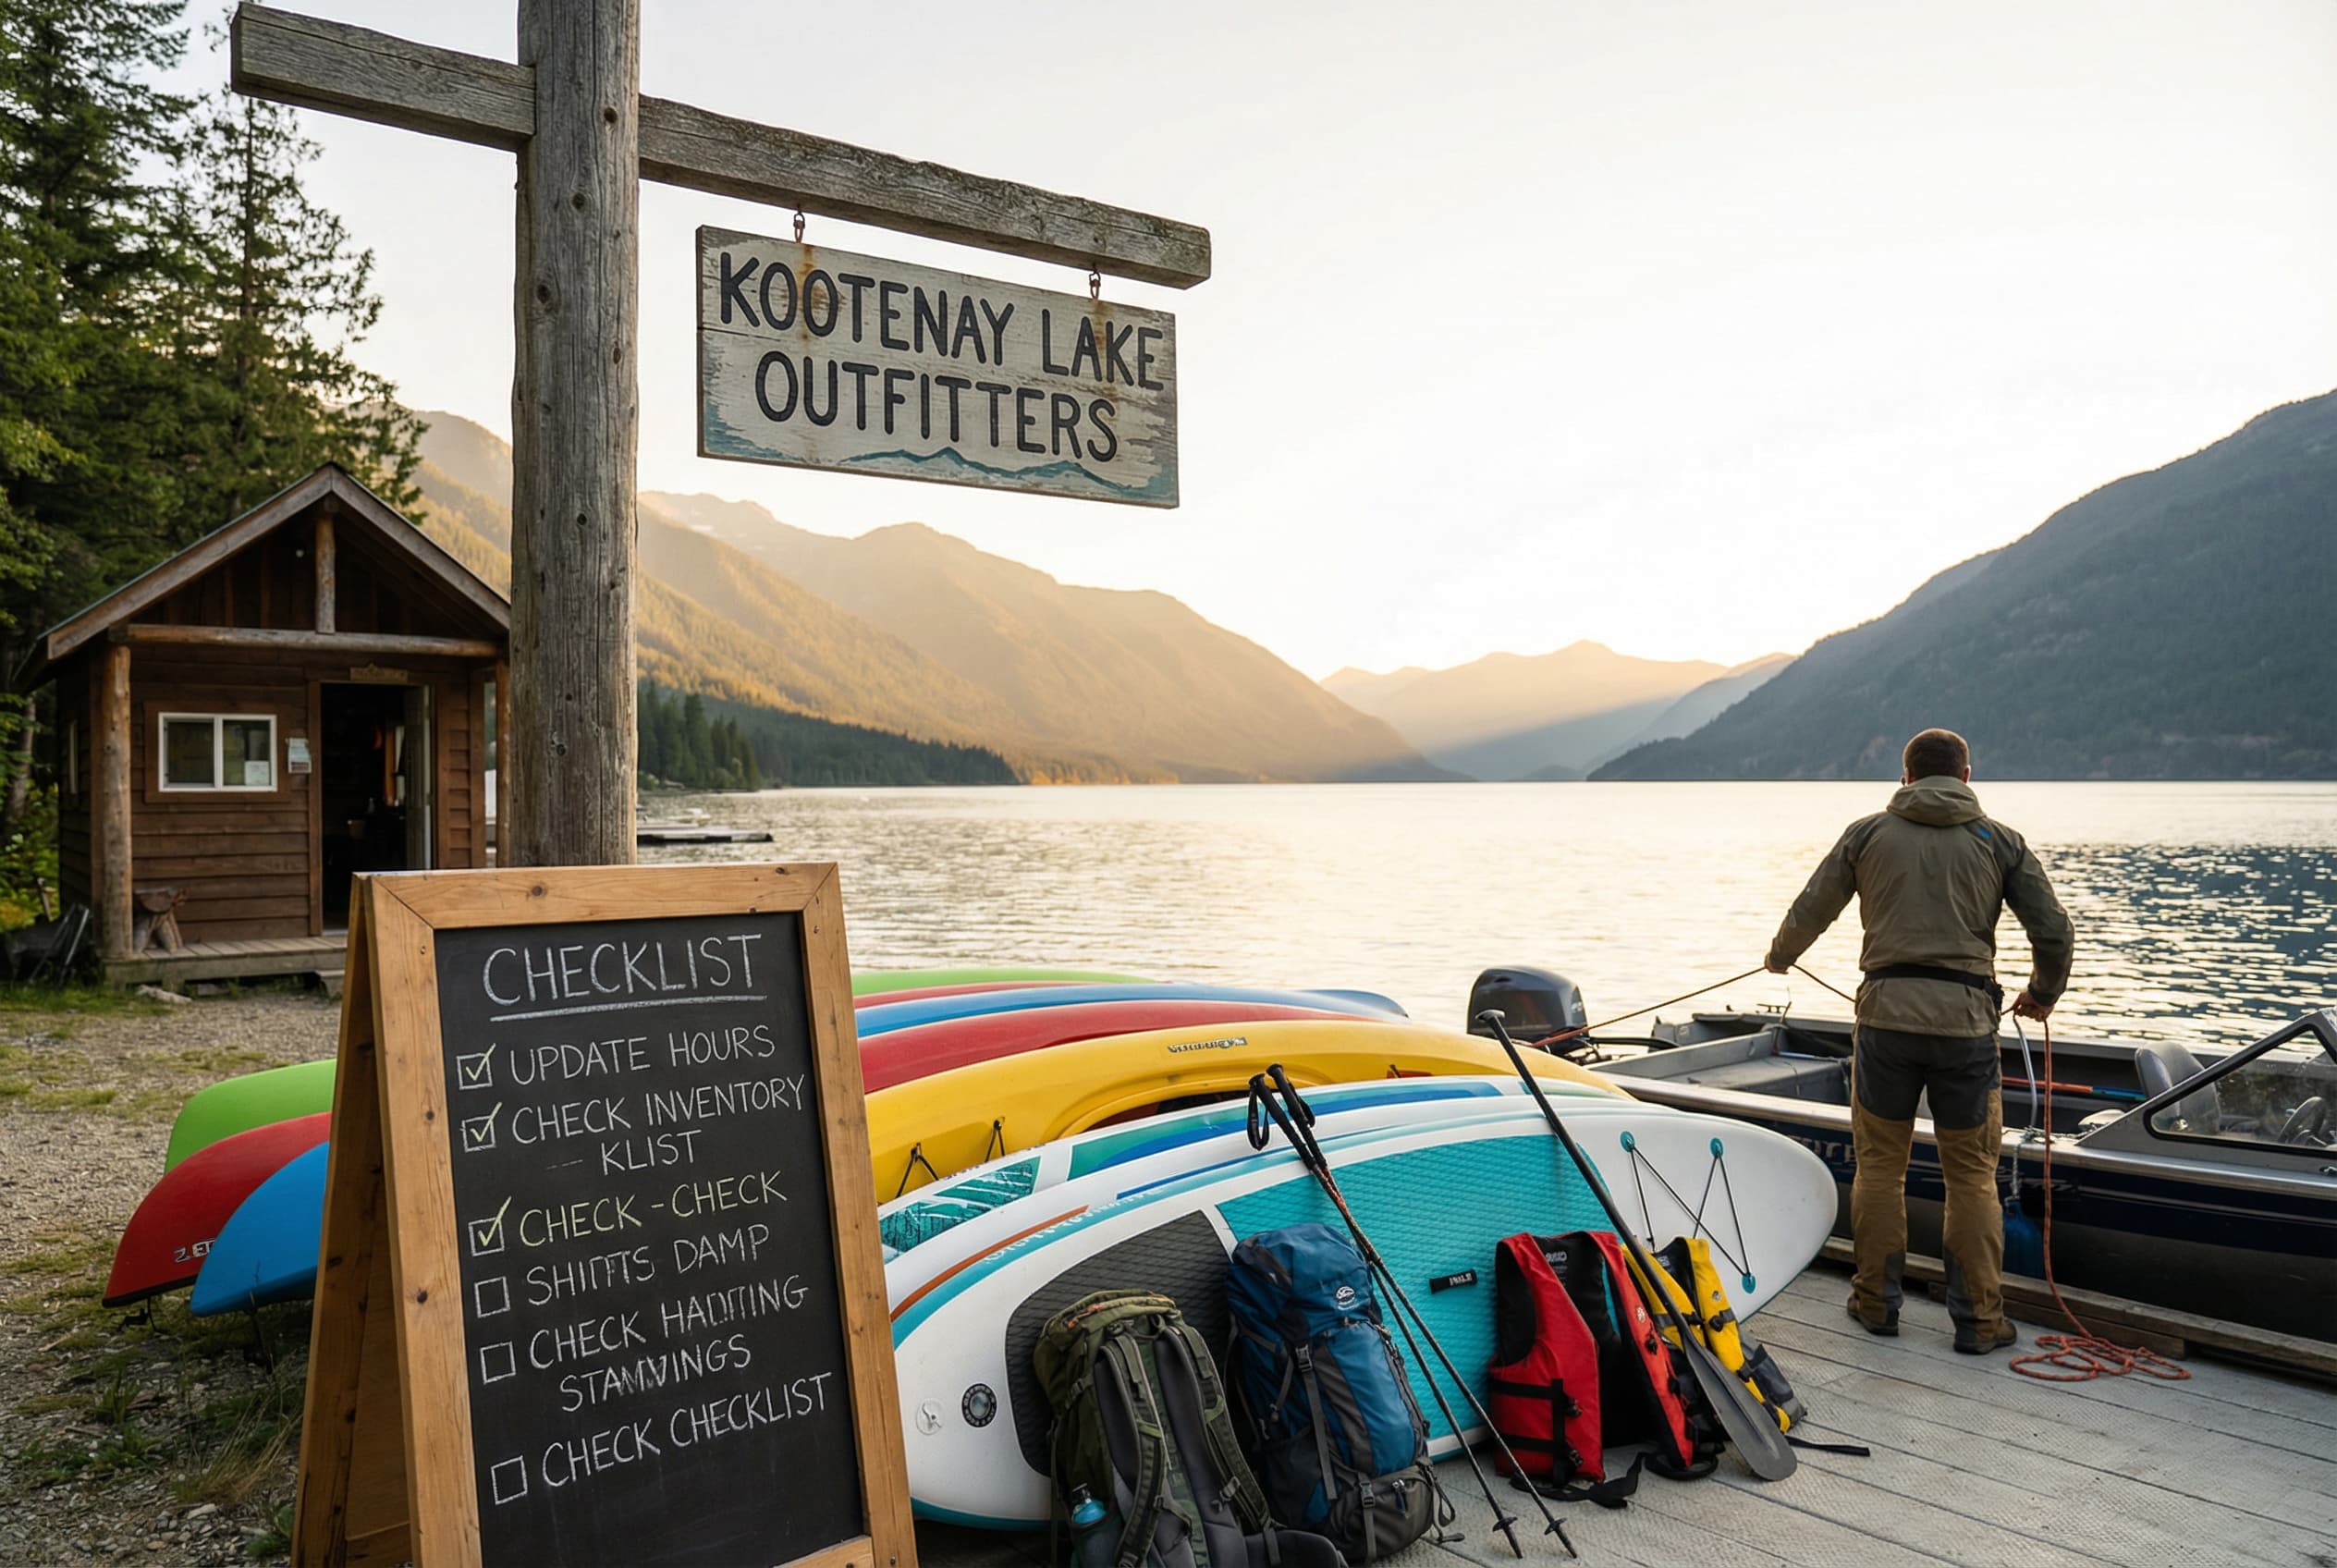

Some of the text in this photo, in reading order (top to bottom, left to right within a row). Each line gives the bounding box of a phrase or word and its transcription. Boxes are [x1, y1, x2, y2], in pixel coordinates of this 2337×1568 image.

[719, 251, 1164, 391] KOOTENAY LAKE
[754, 349, 1118, 463] OUTFITTERS
[483, 933, 762, 1006] CHECKLIST
[510, 1024, 776, 1085] UPDATE HOURS
[511, 1073, 805, 1145] CHECK INVENTORY
[601, 1129, 703, 1176] KLIST
[673, 1223, 769, 1274] DAMP
[530, 1311, 646, 1369] CHECK
[542, 1371, 832, 1488] CHECK CHECKLIST
